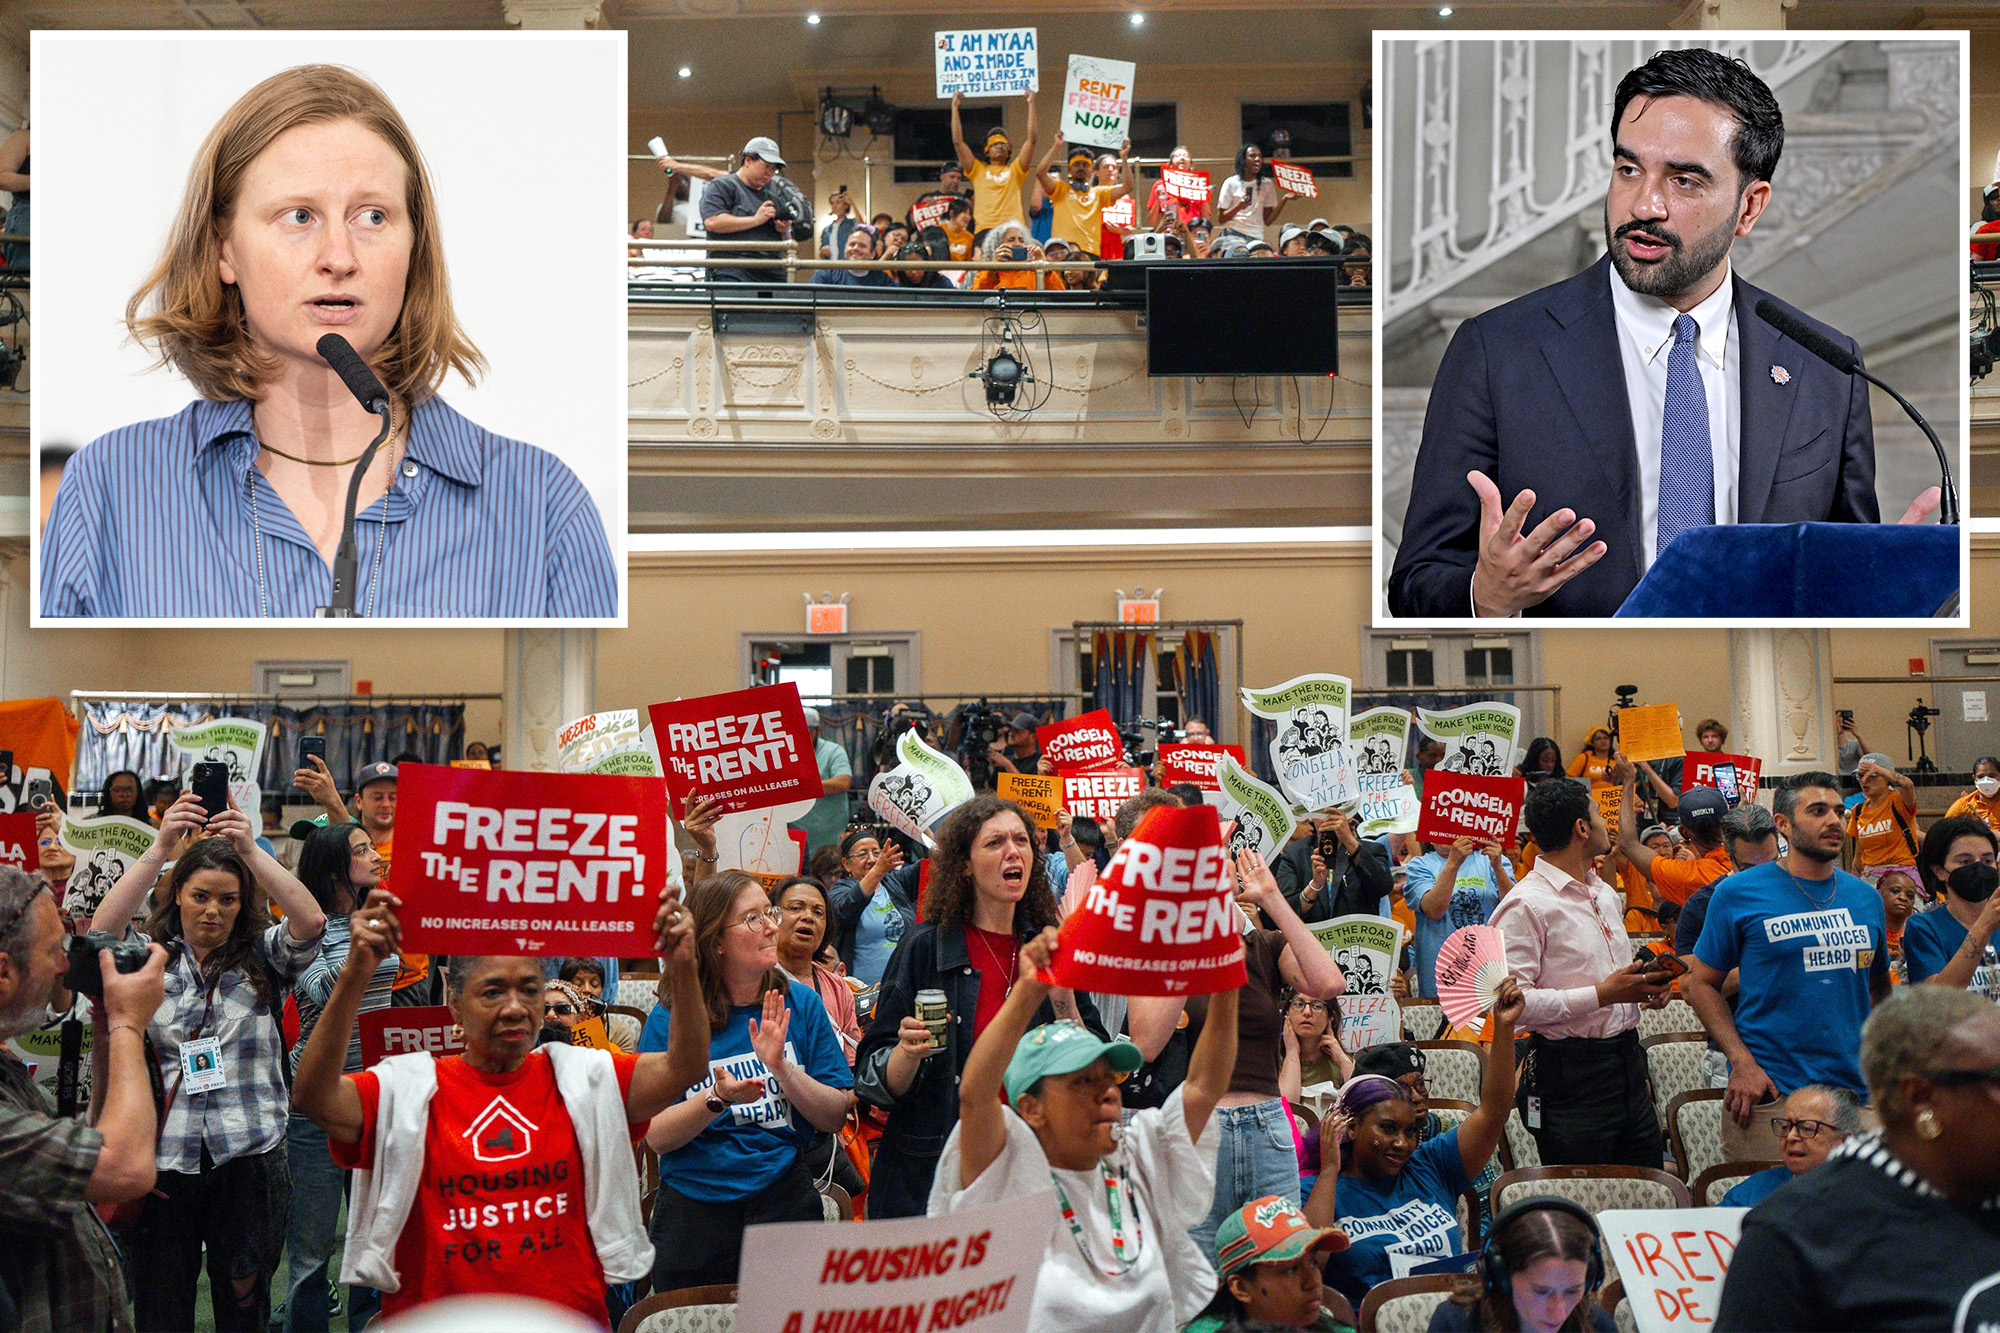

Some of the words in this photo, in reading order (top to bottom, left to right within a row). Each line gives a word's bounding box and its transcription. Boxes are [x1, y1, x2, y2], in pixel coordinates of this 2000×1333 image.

[945, 34, 954, 52] I
[960, 33, 982, 52] AM
[988, 31, 1035, 52] NYAA
[944, 55, 971, 72] AND
[985, 52, 1025, 69] MADE
[967, 69, 1017, 83] DOLLARS
[1020, 68, 1036, 79] IN
[983, 80, 1009, 92] LAST
[1079, 78, 1127, 100] RENT
[1068, 92, 1130, 117] FREEZE
[1075, 111, 1121, 130] NOW
[1163, 168, 1209, 189] FREEZE
[1274, 164, 1314, 185] FREEZE
[811, 606, 845, 633] EXIT
[1123, 602, 1157, 624] EXIT
[1262, 692, 1293, 707] MAKE
[1292, 684, 1313, 698] THE
[1314, 683, 1345, 696] ROAD
[1300, 693, 1320, 704] NEW
[1321, 693, 1343, 704] YORK
[668, 710, 788, 753] FREEZE
[1350, 721, 1366, 733] AKE
[1366, 714, 1383, 727] THE
[1384, 714, 1405, 727] ROAD
[1372, 724, 1387, 733] NEW
[1388, 724, 1403, 734] YORK
[1435, 718, 1464, 729] MAKE
[1465, 713, 1486, 725] THE
[1488, 713, 1514, 727] ROAD
[1472, 723, 1491, 732] NEW
[1493, 724, 1512, 736] YORK
[181, 733, 208, 743] MAKE
[208, 726, 227, 738] THE
[229, 726, 257, 739] ROAD
[214, 735, 233, 743] NEW
[235, 736, 254, 746] YORK
[1046, 728, 1114, 758] ¡CONGELA
[669, 756, 697, 780] THE
[697, 734, 799, 784] RENT!
[908, 744, 932, 765] MAKE
[931, 759, 949, 773] THE
[1053, 753, 1064, 762] LA
[1063, 740, 1116, 762] RENTA!
[1167, 749, 1226, 764] ¡CONGE
[603, 756, 623, 771] THE
[624, 754, 654, 764] ROAD
[610, 765, 629, 775] NEW
[631, 764, 653, 773] YORK
[1173, 761, 1184, 769] LA
[1185, 759, 1218, 777] REN
[1285, 750, 1345, 781] CONGELA
[733, 787, 748, 797] ON
[748, 784, 765, 794] ALL
[764, 778, 800, 791] LEASES
[1011, 777, 1052, 789] FREEZE
[1021, 788, 1053, 798] RENT!
[1065, 777, 1141, 798] FREEZE
[1310, 773, 1328, 793] LA
[1357, 773, 1404, 793] FREEZE
[1228, 774, 1253, 798] MAKE
[1255, 791, 1271, 808] THE
[1270, 804, 1287, 834] ROAD
[1368, 791, 1389, 805] THE
[1430, 788, 1514, 818] ¡CONGELA
[875, 791, 920, 838] FREEZE
[1067, 800, 1097, 818] THE
[1362, 798, 1401, 821] RENT
[1691, 807, 1715, 818] BROOKLYN
[433, 800, 639, 858] FREEZE
[1254, 803, 1271, 818] NEW
[1269, 816, 1282, 839] YORK
[1436, 808, 1449, 817] LA
[1450, 807, 1510, 835] RENTA!
[70, 828, 98, 840] MAKE
[99, 826, 119, 838] THE
[120, 828, 151, 848] ROAD
[103, 838, 123, 847] NEW
[124, 840, 146, 856] YORK
[421, 851, 481, 893] THE
[486, 853, 646, 904] RENT!
[1086, 884, 1137, 932] THE
[421, 917, 443, 929] NO
[446, 918, 528, 931] INCREASES
[530, 918, 552, 931] ON
[554, 919, 580, 932] ALL
[581, 920, 635, 933] LEASES
[1335, 925, 1358, 938] THE
[1360, 925, 1394, 941] ROAD
[1770, 913, 1848, 937] COMMUNITY
[1343, 936, 1366, 945] NEW
[1368, 936, 1392, 950] YORK
[1822, 928, 1868, 947] VOICES
[1073, 949, 1096, 965] NO
[1097, 953, 1178, 973] INCREASES
[1178, 957, 1197, 972] ON
[1809, 948, 1851, 967] HEARD
[1339, 996, 1391, 1017] REEZE
[1343, 1015, 1372, 1029] THE
[29, 1034, 62, 1046] MAK
[383, 1024, 468, 1053] FREE
[1338, 1028, 1380, 1053] ENT
[438, 1159, 569, 1198] HOUSING
[442, 1192, 569, 1231] JUSTICE
[1342, 1203, 1425, 1239] COMMUNITY
[1400, 1207, 1452, 1242] VOICES
[444, 1238, 502, 1264] FOR
[518, 1227, 564, 1255] ALL
[820, 1237, 958, 1285] HOUSING
[960, 1229, 992, 1270] IS
[780, 1311, 804, 1333] A
[812, 1302, 925, 1333] HUMAN
[926, 1274, 1016, 1333] RIGHT!
[1654, 1287, 1713, 1324] DE
